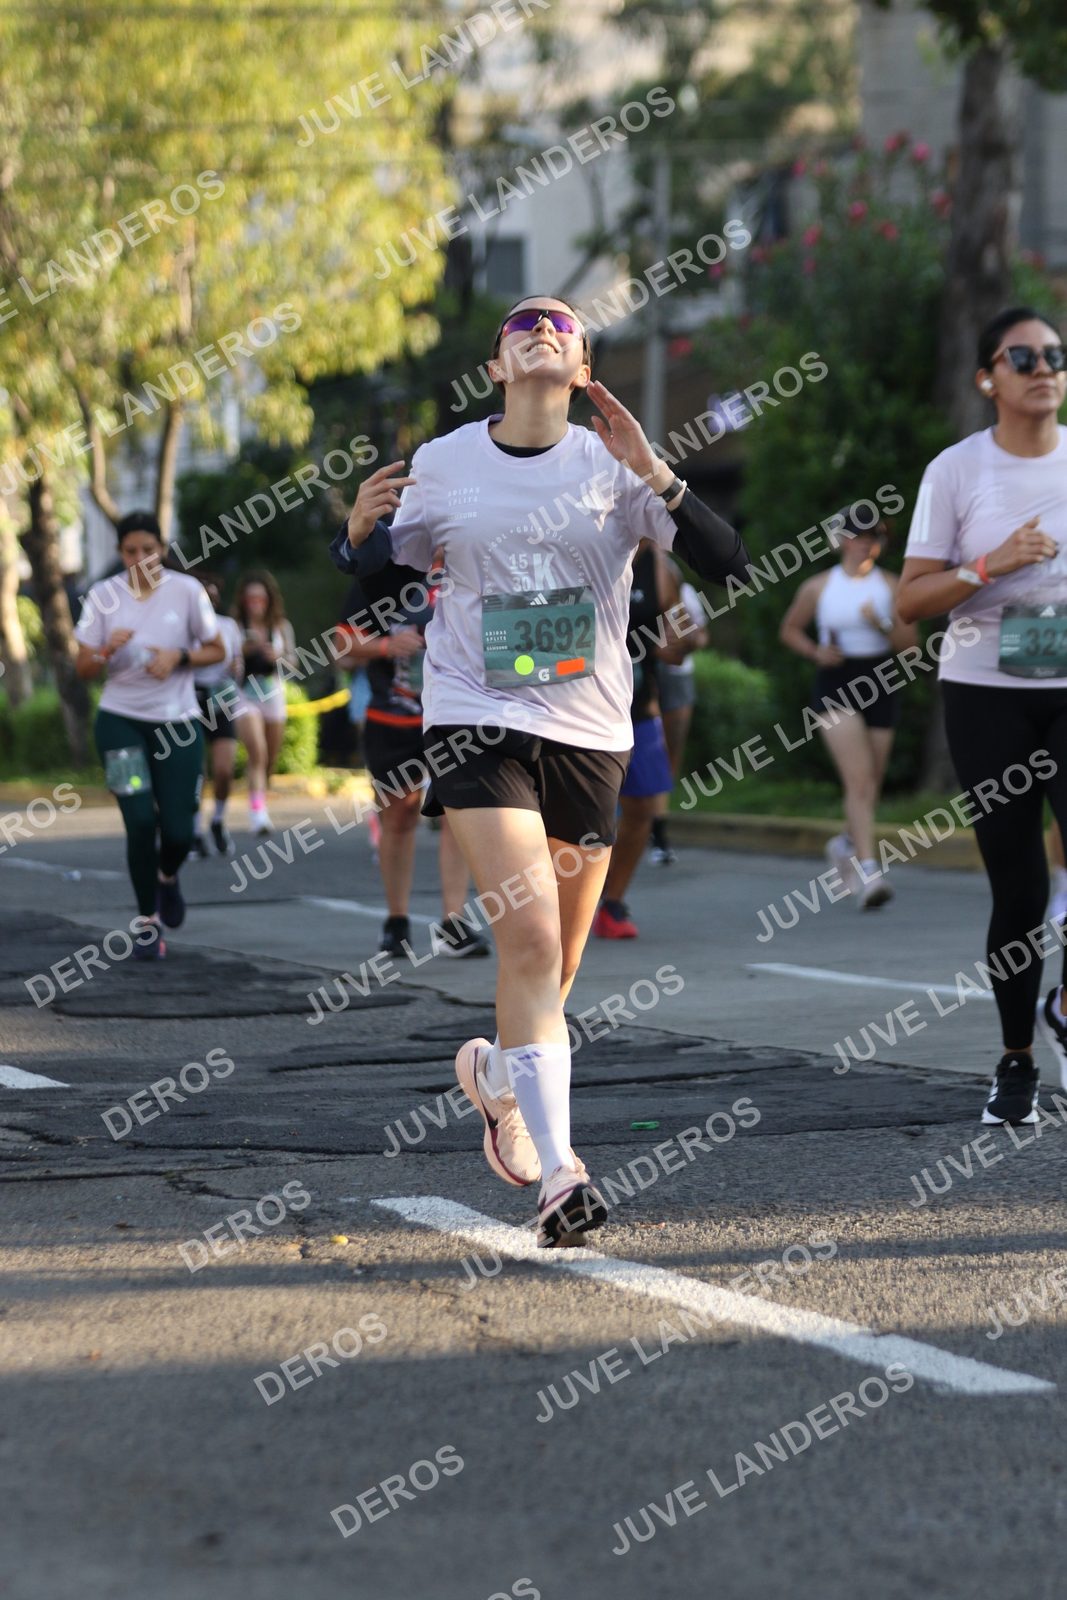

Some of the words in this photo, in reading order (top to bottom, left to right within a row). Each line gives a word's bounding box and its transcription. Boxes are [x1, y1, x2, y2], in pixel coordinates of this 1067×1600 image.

[508, 553, 529, 570] 15
[532, 552, 558, 591] K
[512, 575, 531, 592] 30
[514, 614, 592, 653] 3692
[1025, 627, 1067, 657] 32
